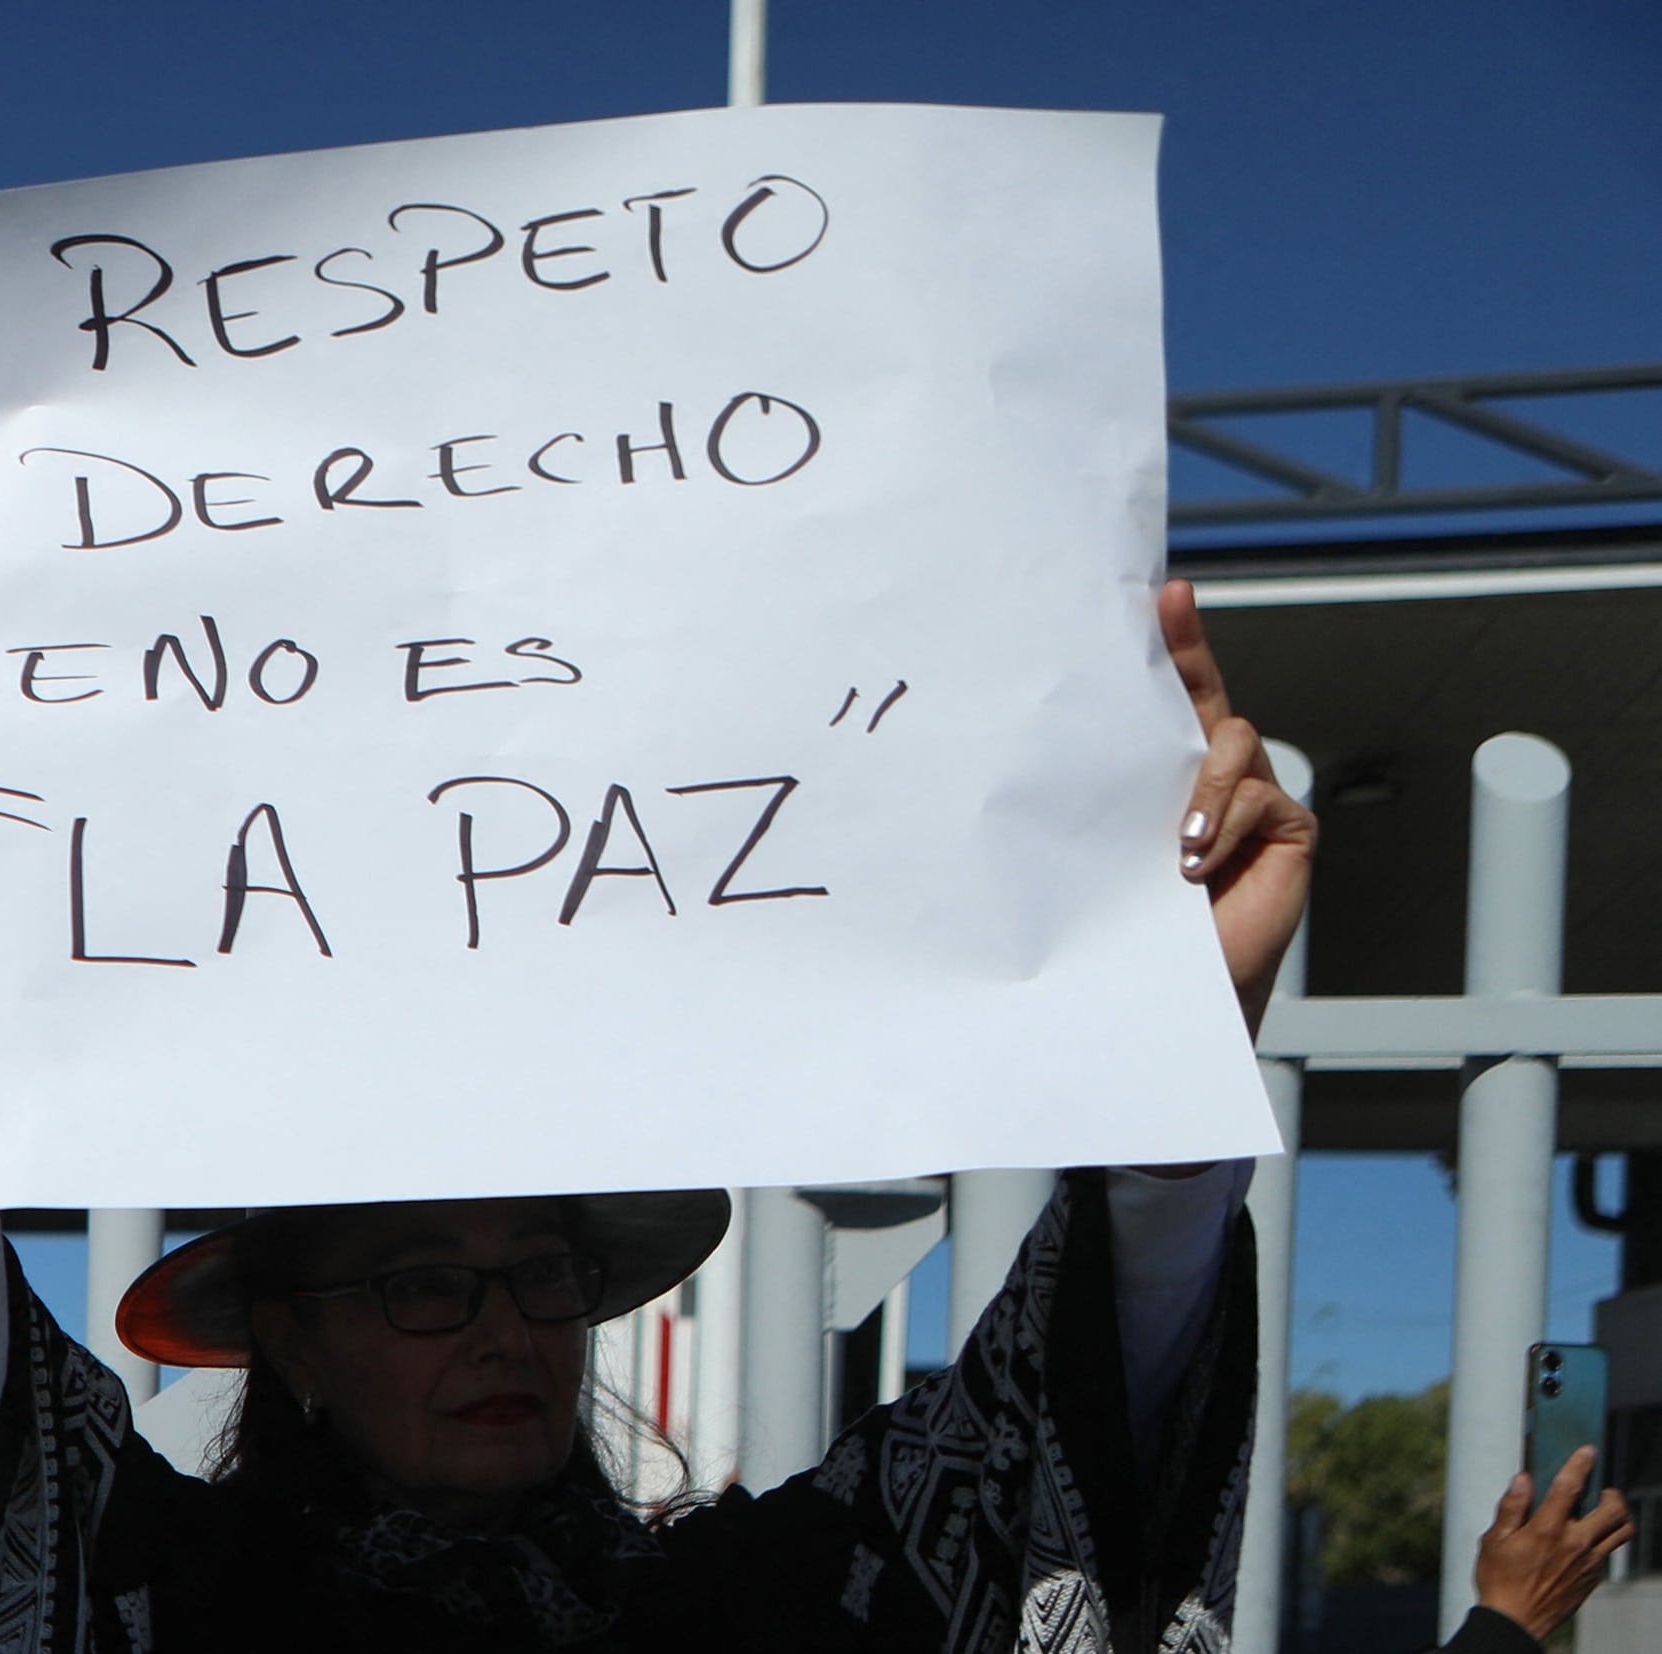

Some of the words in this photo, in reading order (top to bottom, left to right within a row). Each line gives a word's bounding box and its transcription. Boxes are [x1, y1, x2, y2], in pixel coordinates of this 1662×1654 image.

[50, 174, 830, 371] RESPETO
[19, 391, 822, 550] DERECHO
[395, 636, 583, 704] ES
